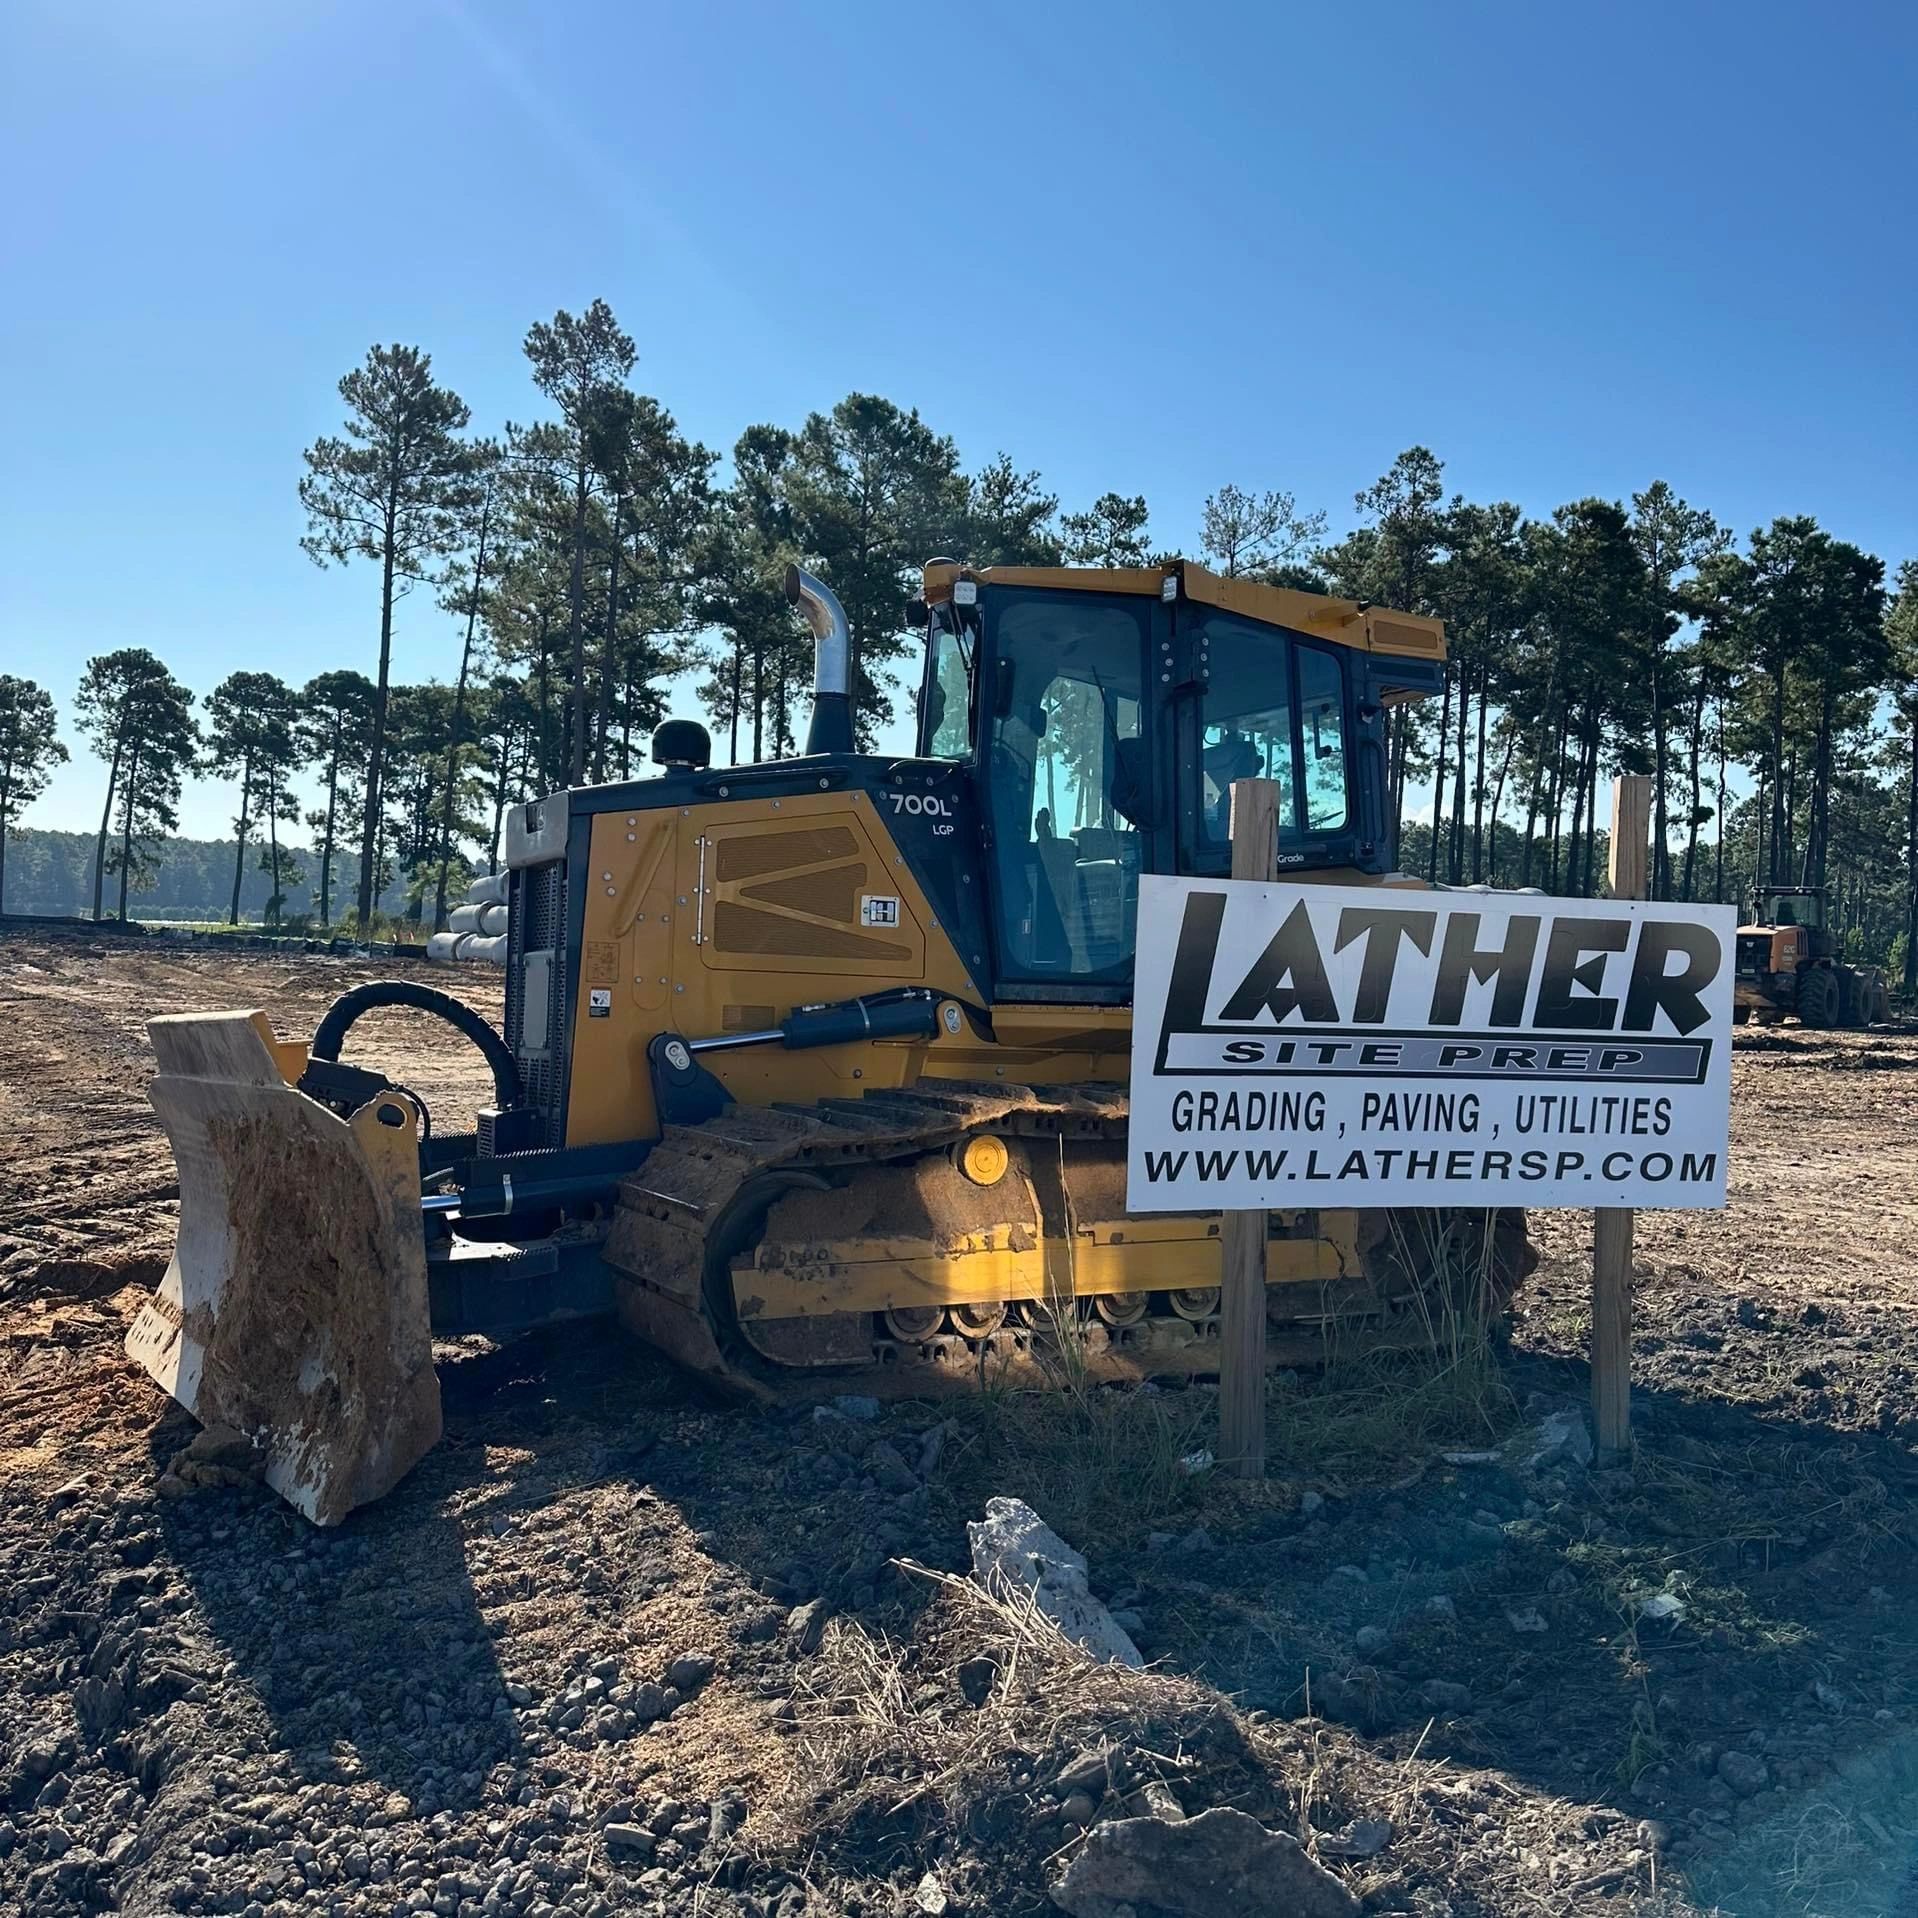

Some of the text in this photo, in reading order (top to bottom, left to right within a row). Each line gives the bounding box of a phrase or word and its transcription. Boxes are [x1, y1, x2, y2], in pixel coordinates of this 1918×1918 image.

[889, 793, 953, 817] 700L
[932, 824, 955, 836] LGP
[1153, 891, 1722, 1075] LATHER
[1221, 1040, 1644, 1072] SITE PREP
[1515, 1095, 1673, 1137] UTILITIES
[1143, 1149, 1718, 1183] WWW.LATHERSP.COM
